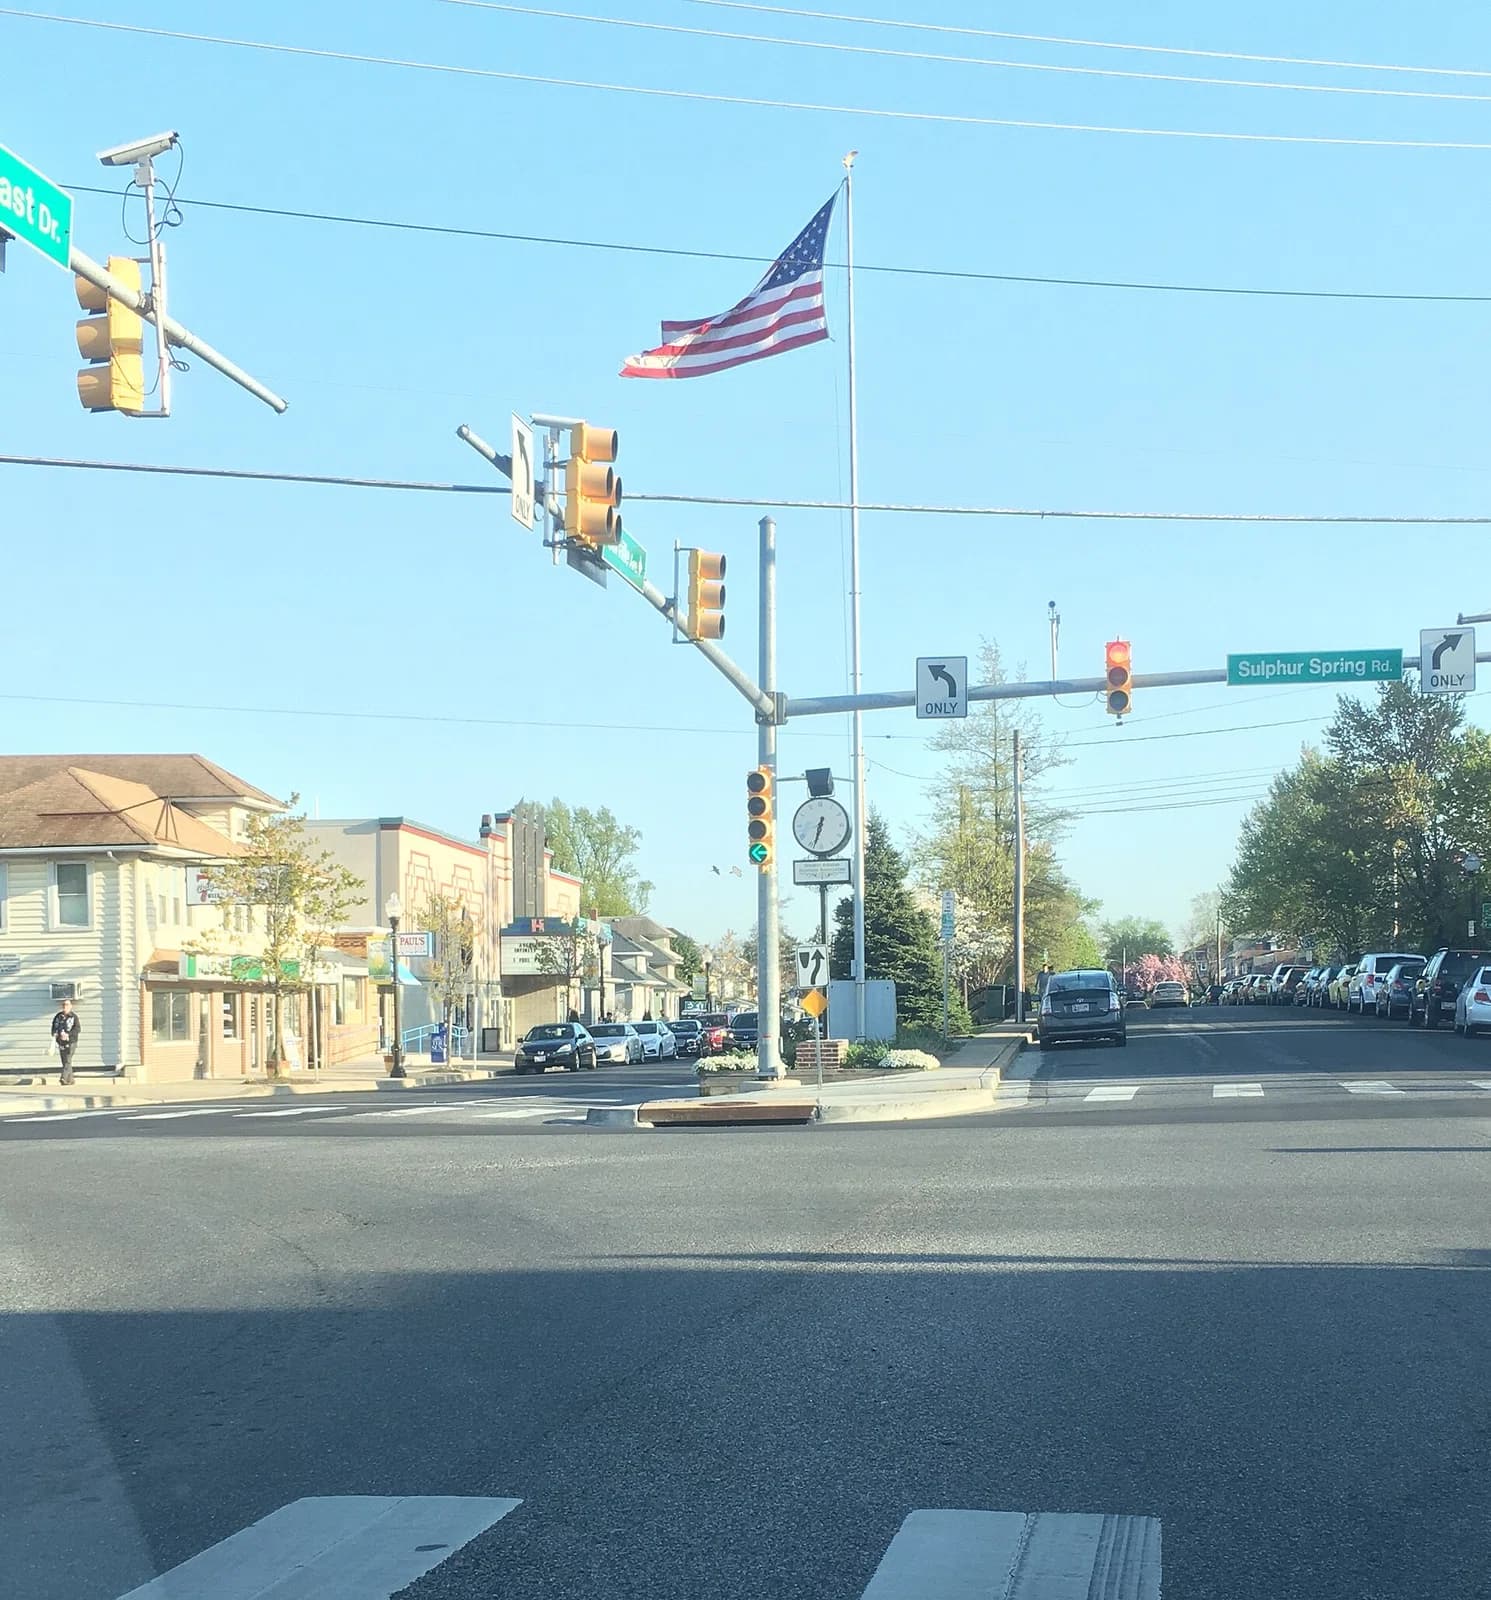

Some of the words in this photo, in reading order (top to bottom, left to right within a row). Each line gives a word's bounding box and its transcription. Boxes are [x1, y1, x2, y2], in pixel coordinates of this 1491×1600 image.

[38, 202, 62, 244] Dr.
[515, 493, 532, 521] ONLY
[1238, 659, 1305, 679] Sulphur
[1309, 657, 1366, 677] Spring
[1371, 659, 1393, 673] Rd.
[1430, 673, 1466, 687] ONLY
[925, 702, 958, 714] ONLY
